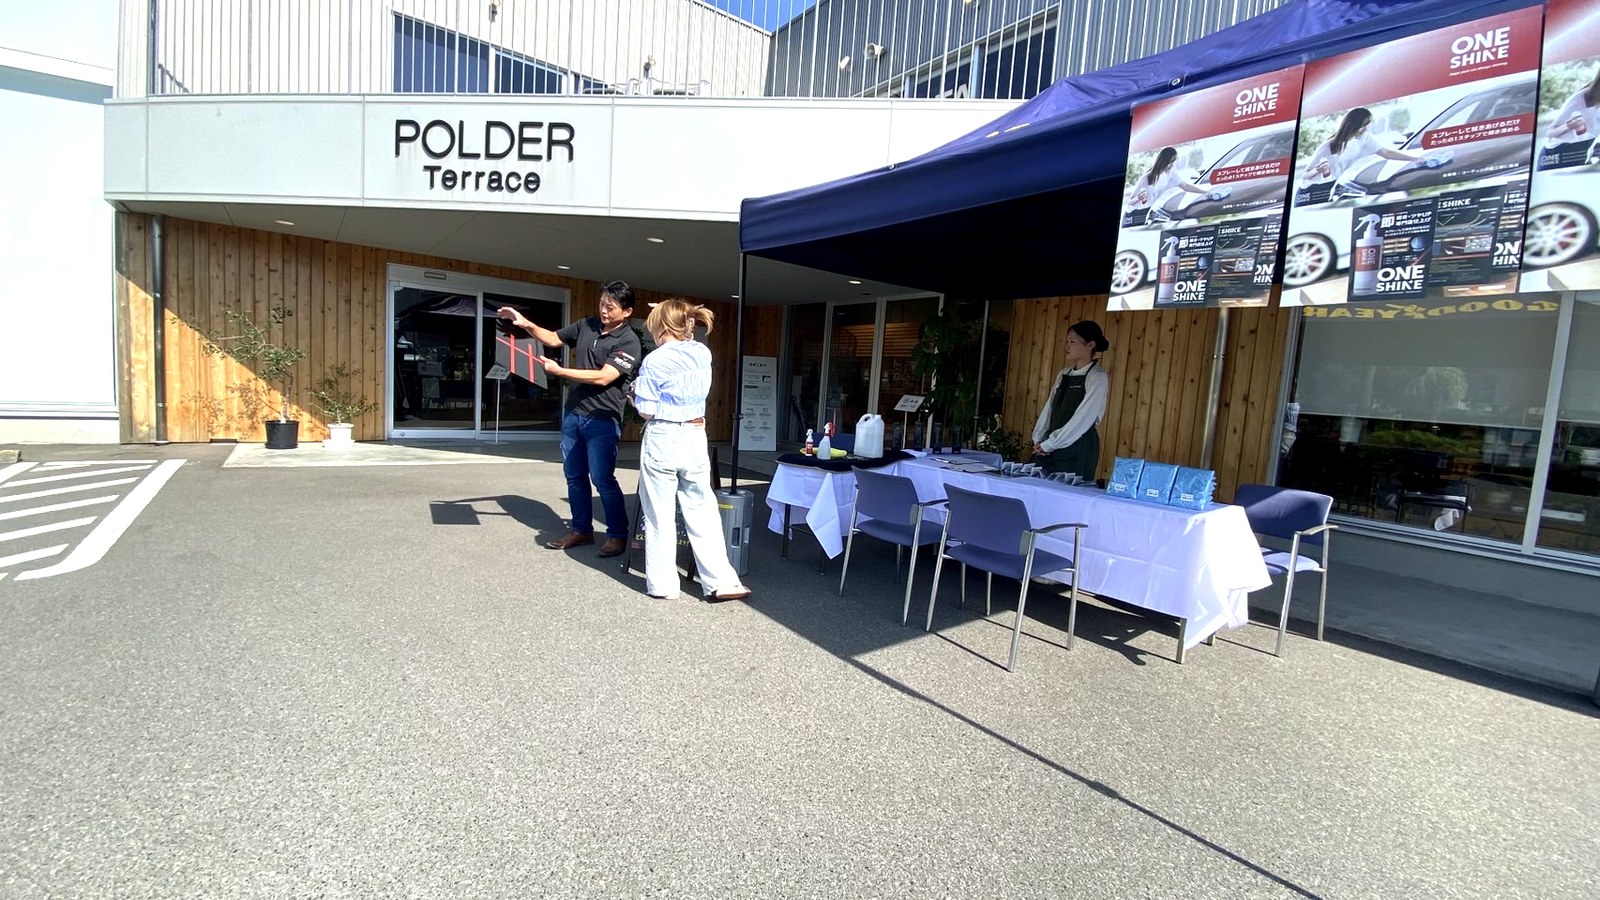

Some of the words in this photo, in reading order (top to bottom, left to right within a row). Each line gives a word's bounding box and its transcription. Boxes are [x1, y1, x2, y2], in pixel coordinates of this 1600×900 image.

[1451, 26, 1510, 55] ONE
[1449, 45, 1509, 69] SHINE
[1235, 82, 1280, 105] ONE
[1233, 98, 1278, 117] SHINE
[395, 119, 575, 163] POLDER
[423, 165, 541, 194] Terrace
[1442, 198, 1471, 208] SHINE
[1377, 264, 1425, 281] ONE
[1174, 280, 1207, 292] ONE
[1375, 280, 1423, 292] SHINE
[1173, 292, 1205, 301] SHINE
